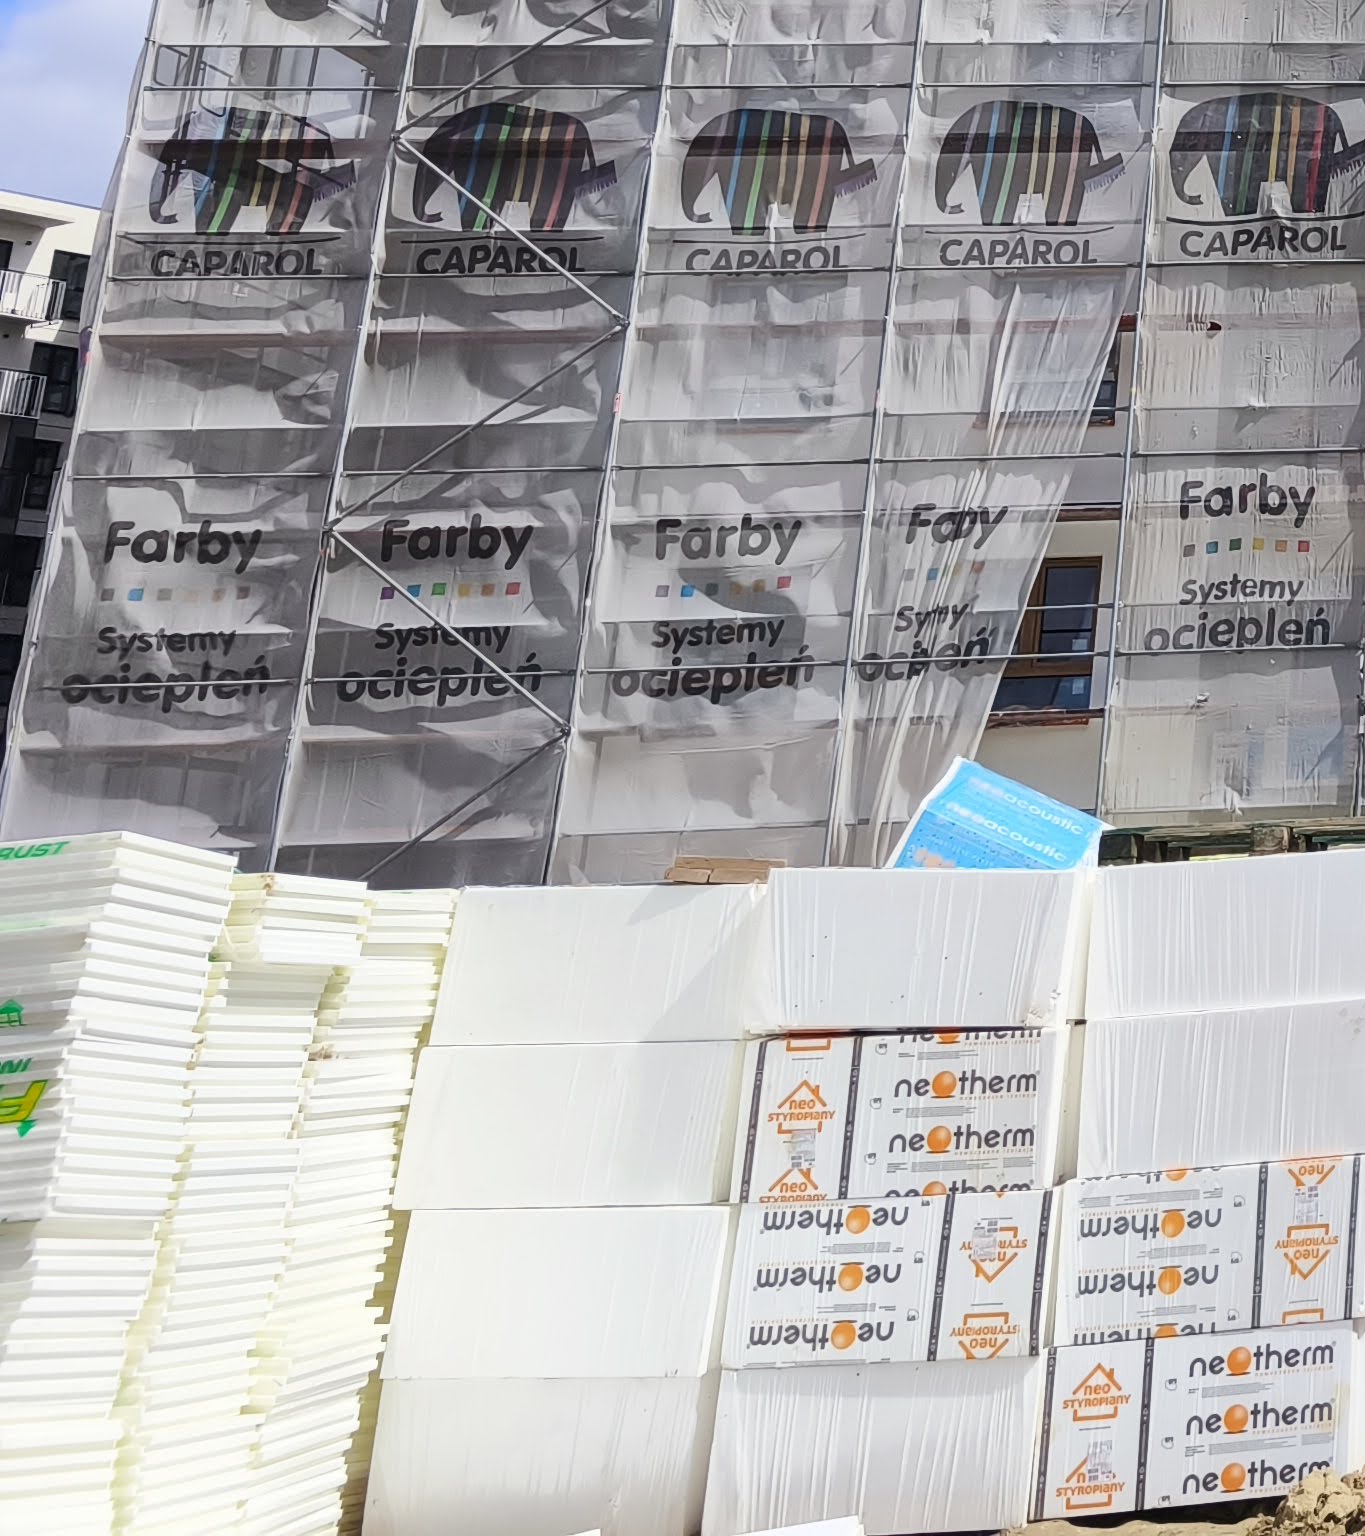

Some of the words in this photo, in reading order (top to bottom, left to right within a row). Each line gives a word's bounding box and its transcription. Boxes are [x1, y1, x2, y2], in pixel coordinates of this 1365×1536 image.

[938, 238, 1098, 266] CAPAROL
[1178, 225, 1347, 260] CAPAROL
[150, 245, 323, 278] CAPAROL
[416, 244, 587, 275] CAPAROL
[686, 246, 849, 276] CAPAROL
[1180, 472, 1317, 529] Farby
[104, 519, 264, 574] Farby
[380, 514, 534, 570] Farby
[655, 513, 803, 566] Farby
[1180, 571, 1304, 607] Systemy
[97, 625, 237, 657] Systemy
[374, 621, 511, 653] Systemy
[651, 616, 785, 652] Systemy
[1145, 604, 1331, 658] ociepleń
[61, 653, 271, 713] ociepleń
[336, 652, 542, 707] ociepleń
[611, 642, 815, 705] ociepleń
[893, 1068, 1039, 1098] neotherm
[788, 1098, 816, 1111] neo
[888, 1123, 1035, 1153] neotherm
[1298, 1163, 1325, 1176] neo
[779, 1180, 808, 1193] neo
[762, 1204, 910, 1235] neotherm
[1079, 1208, 1223, 1241] neotherm
[1293, 1248, 1320, 1260] neo
[755, 1261, 903, 1294] neotherm
[1077, 1264, 1220, 1298] neotherm
[748, 1319, 896, 1352] neotherm
[969, 1338, 999, 1350] neo
[1188, 1342, 1335, 1378] neotherm
[1083, 1382, 1112, 1396] neo
[1185, 1400, 1333, 1436] neotherm
